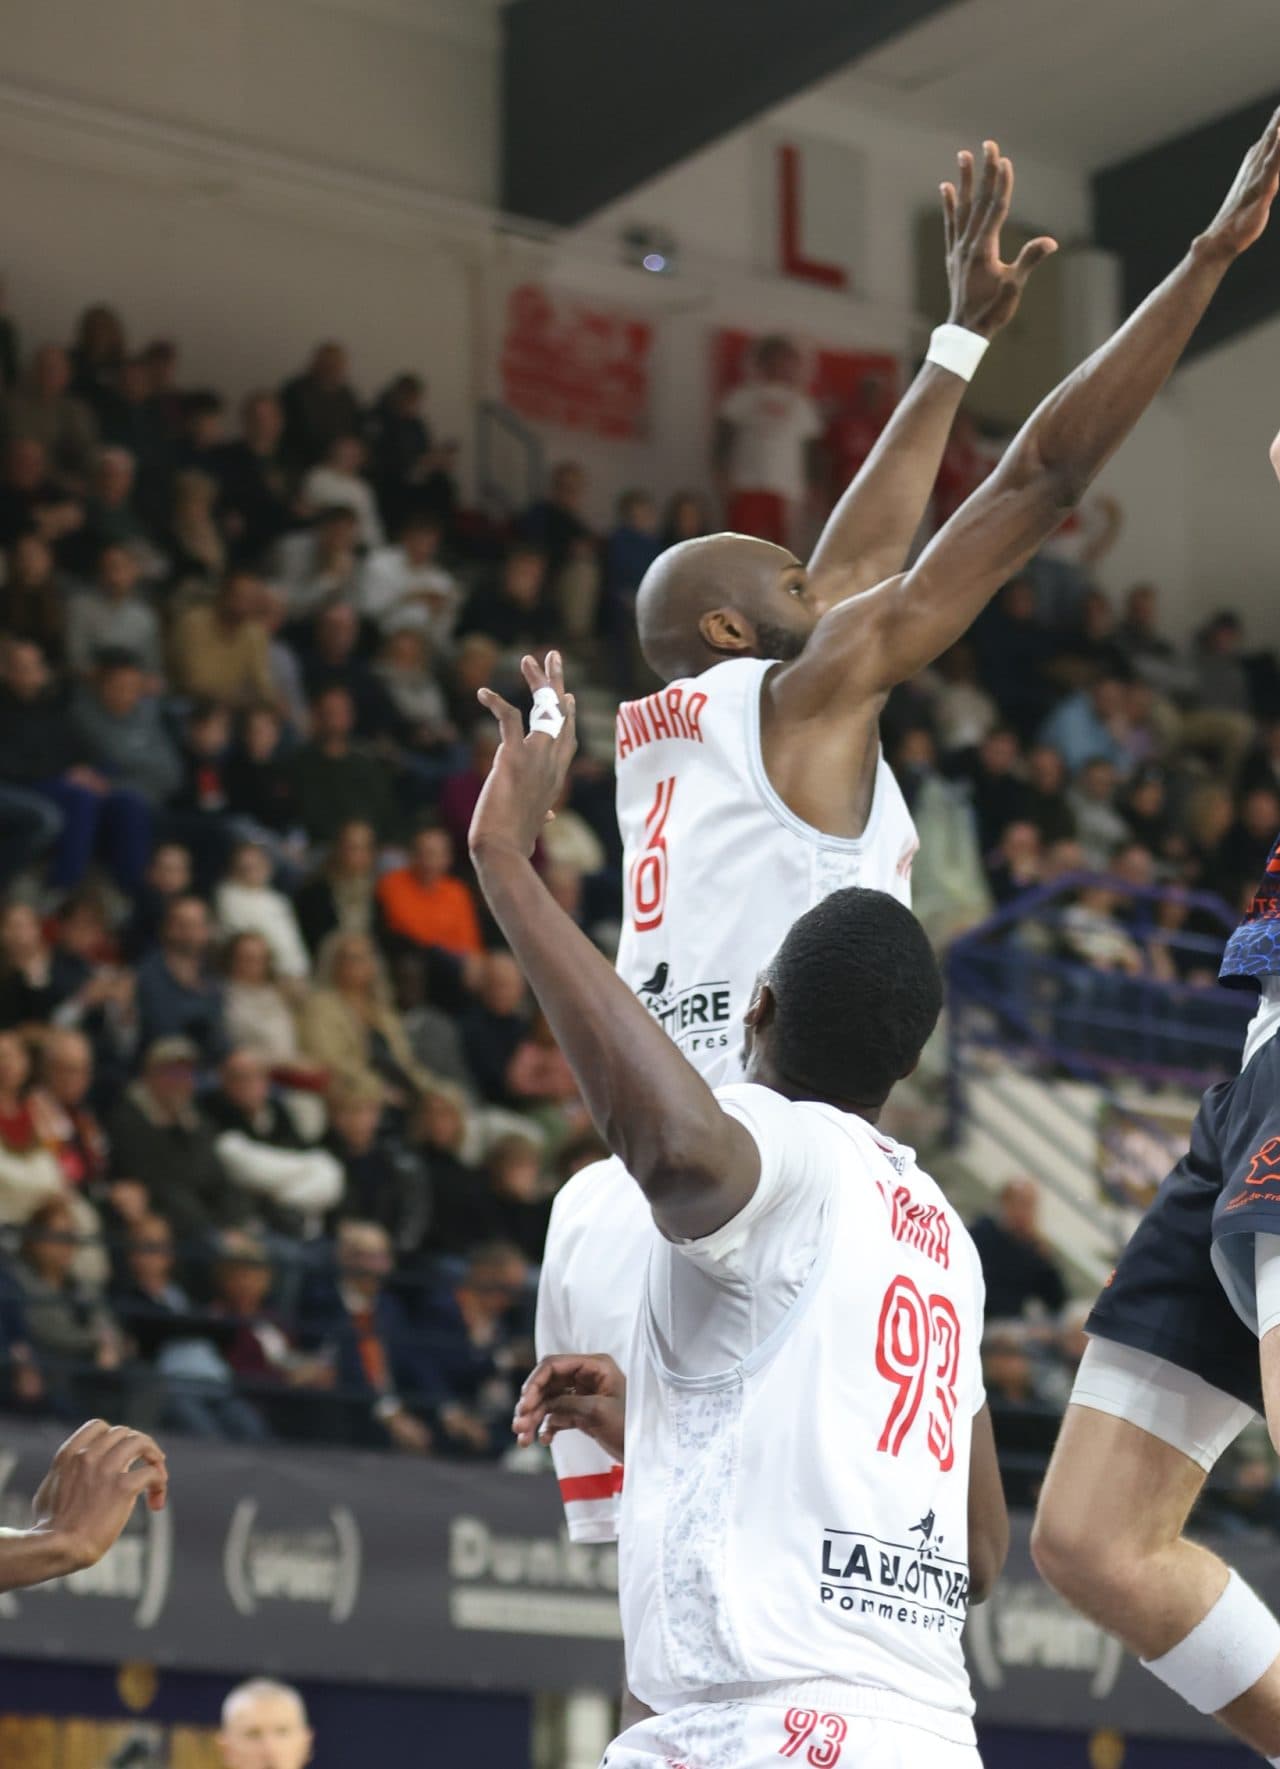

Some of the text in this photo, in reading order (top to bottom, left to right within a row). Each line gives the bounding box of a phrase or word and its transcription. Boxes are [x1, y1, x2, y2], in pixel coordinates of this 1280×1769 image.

[876, 1274, 960, 1472] 93
[821, 1539, 873, 1582] LA
[779, 1706, 848, 1769] 93
